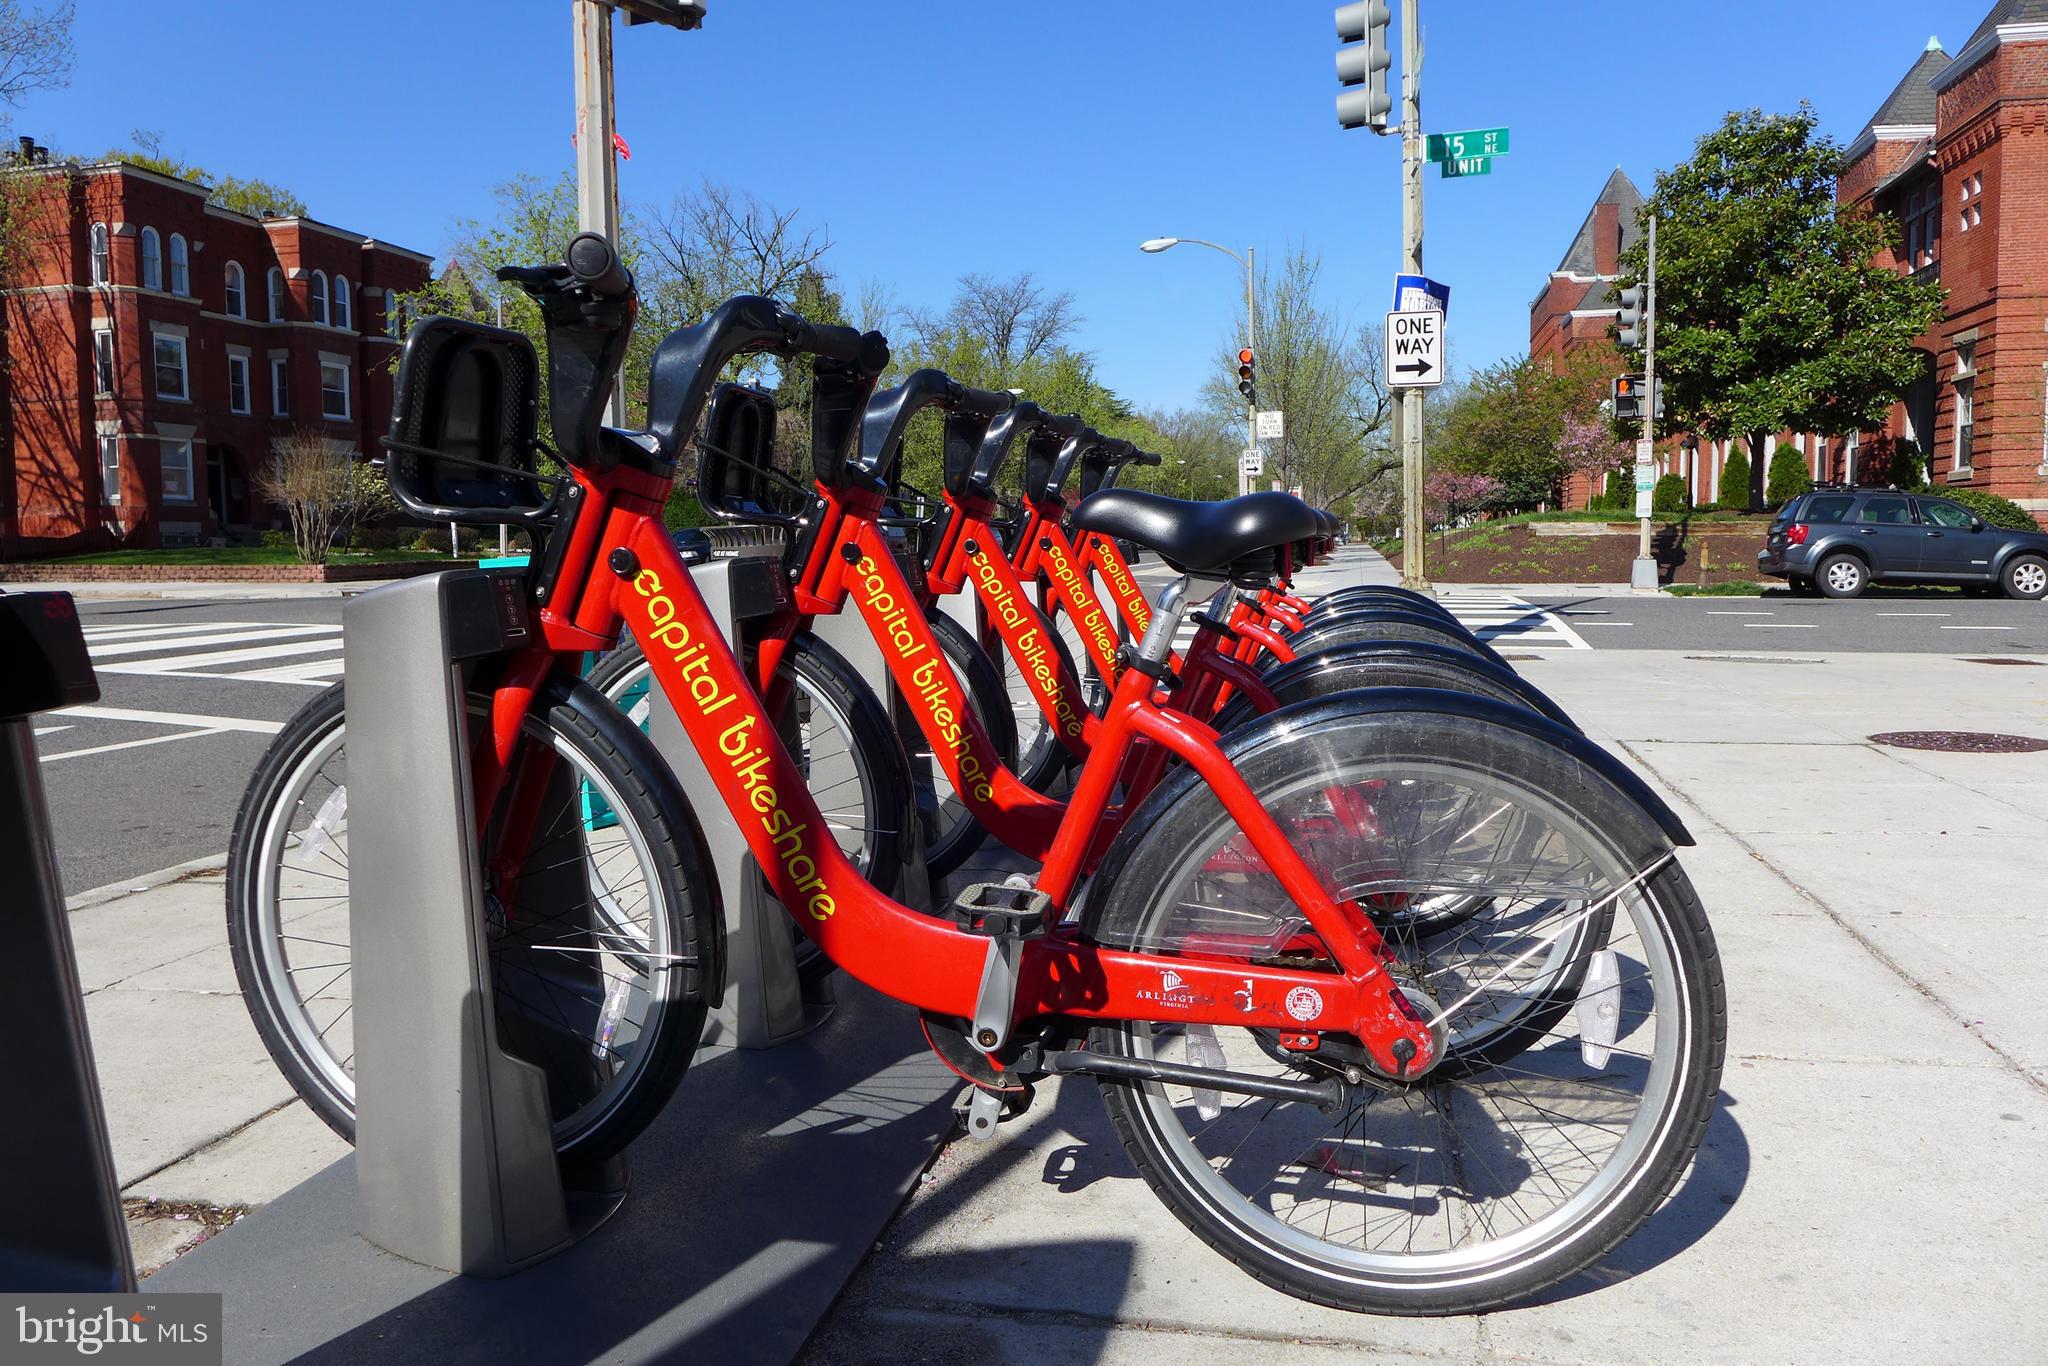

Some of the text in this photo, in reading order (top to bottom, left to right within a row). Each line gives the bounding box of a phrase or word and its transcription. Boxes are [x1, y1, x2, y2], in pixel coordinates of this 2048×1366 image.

[1444, 132, 1498, 157] 15 ST
[1484, 143, 1498, 154] NE
[1447, 158, 1484, 175] UNIT
[1396, 317, 1434, 335] ONE
[1395, 337, 1435, 355] WAY
[1048, 545, 1093, 609] capital
[1098, 544, 1136, 597] capital
[972, 551, 1081, 736] capital bikeshare
[856, 556, 993, 802] capital bikeshare
[633, 569, 835, 921] capital bikeshare
[1136, 990, 1200, 1003] ARLINGT
